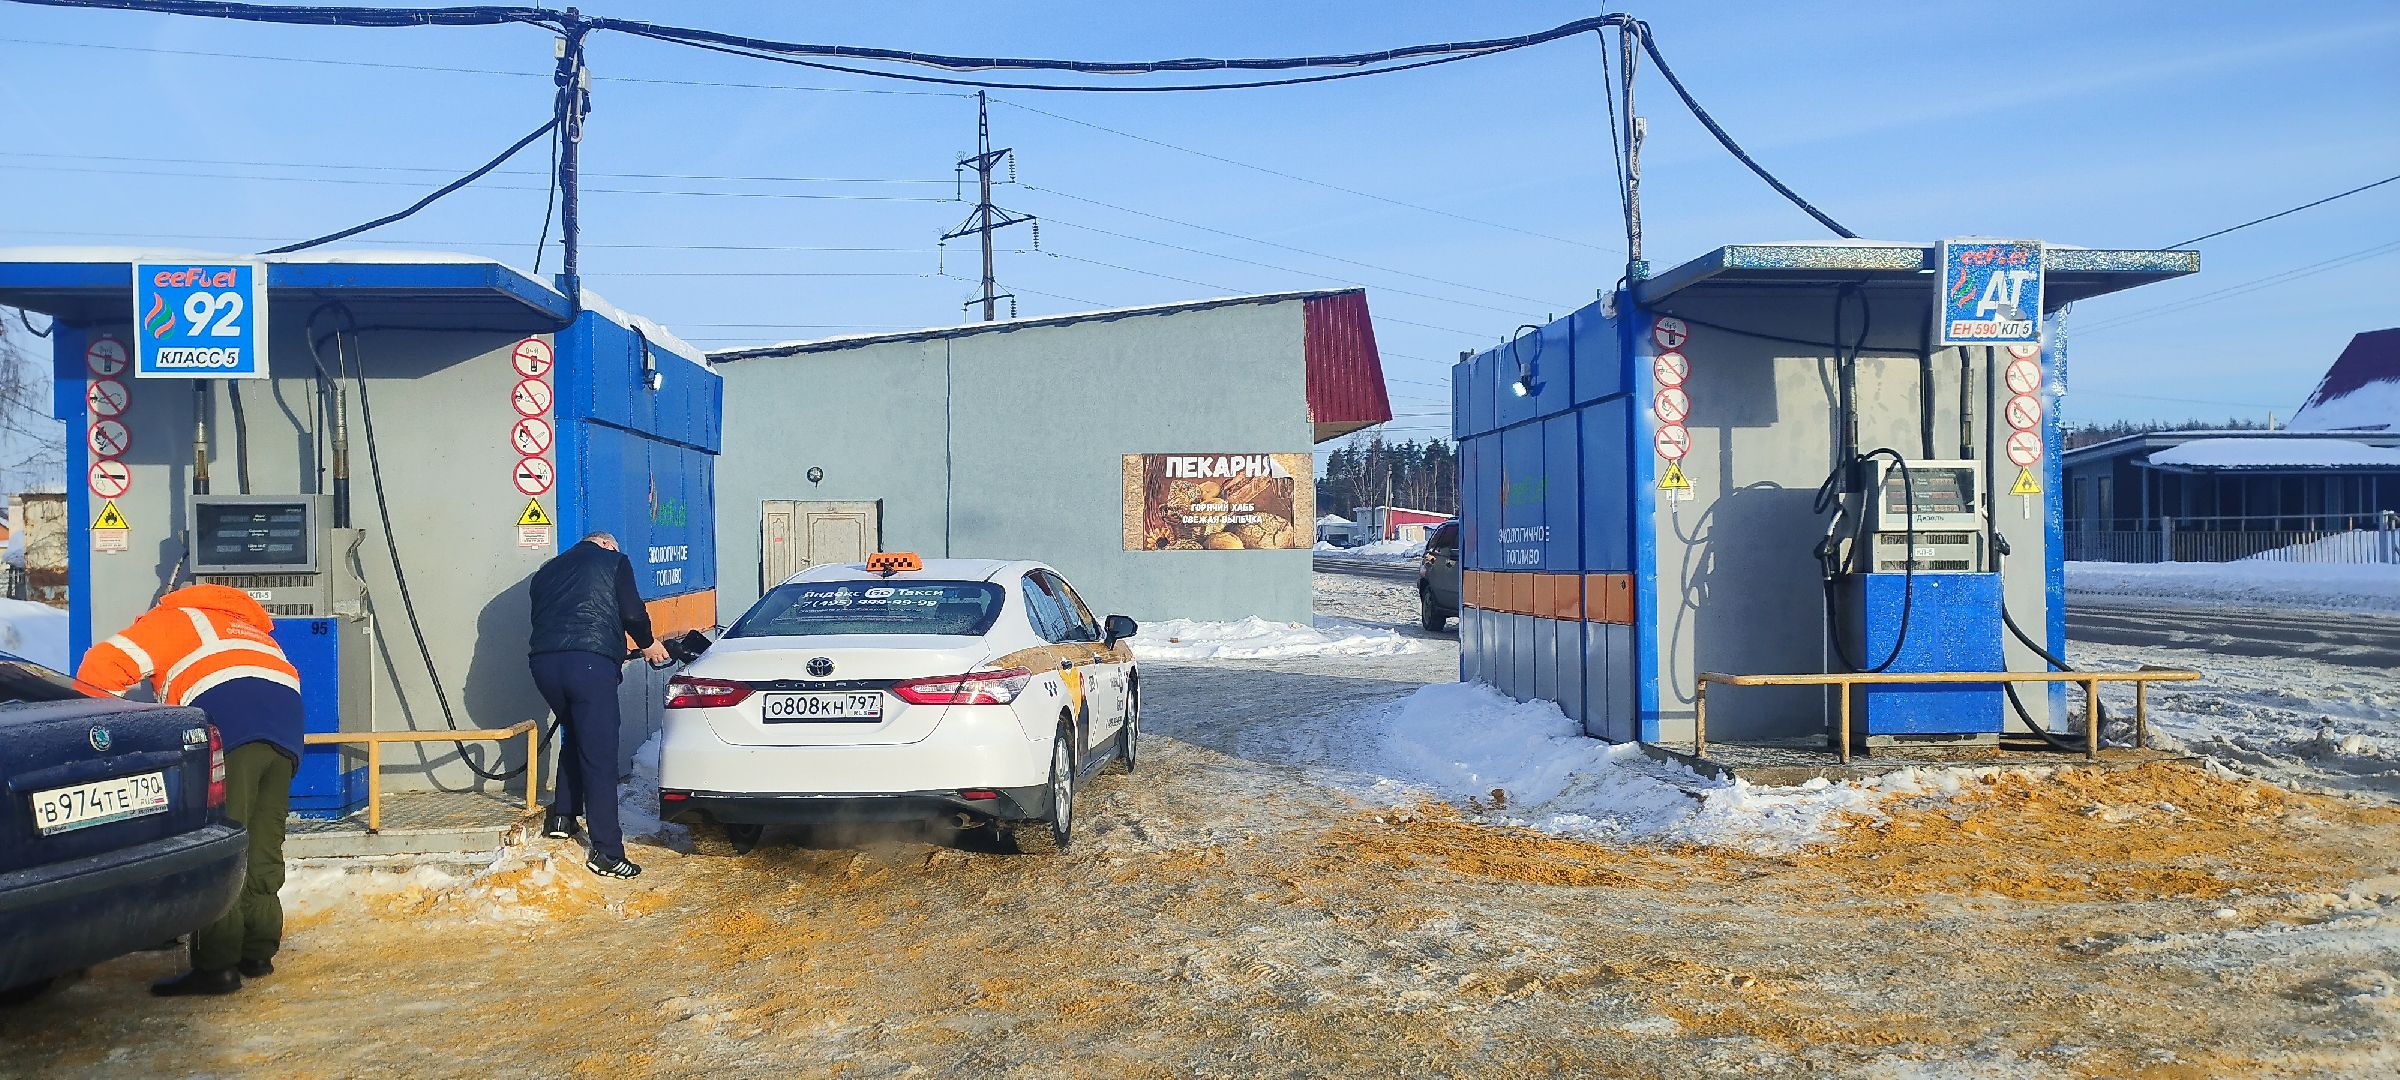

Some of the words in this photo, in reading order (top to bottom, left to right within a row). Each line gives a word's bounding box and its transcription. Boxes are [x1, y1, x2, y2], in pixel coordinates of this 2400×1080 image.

[184, 291, 244, 337] 92
[1975, 323, 1997, 335] 590
[2001, 323, 2019, 335] КЛ
[2022, 323, 2030, 335] 5
[160, 351, 220, 365] КЛАСС
[225, 351, 236, 365] 5
[898, 588, 944, 597] Такси
[311, 621, 328, 635] 95
[848, 695, 877, 710] 797
[44, 787, 130, 823] В974ТЕ
[130, 776, 161, 799] 790
